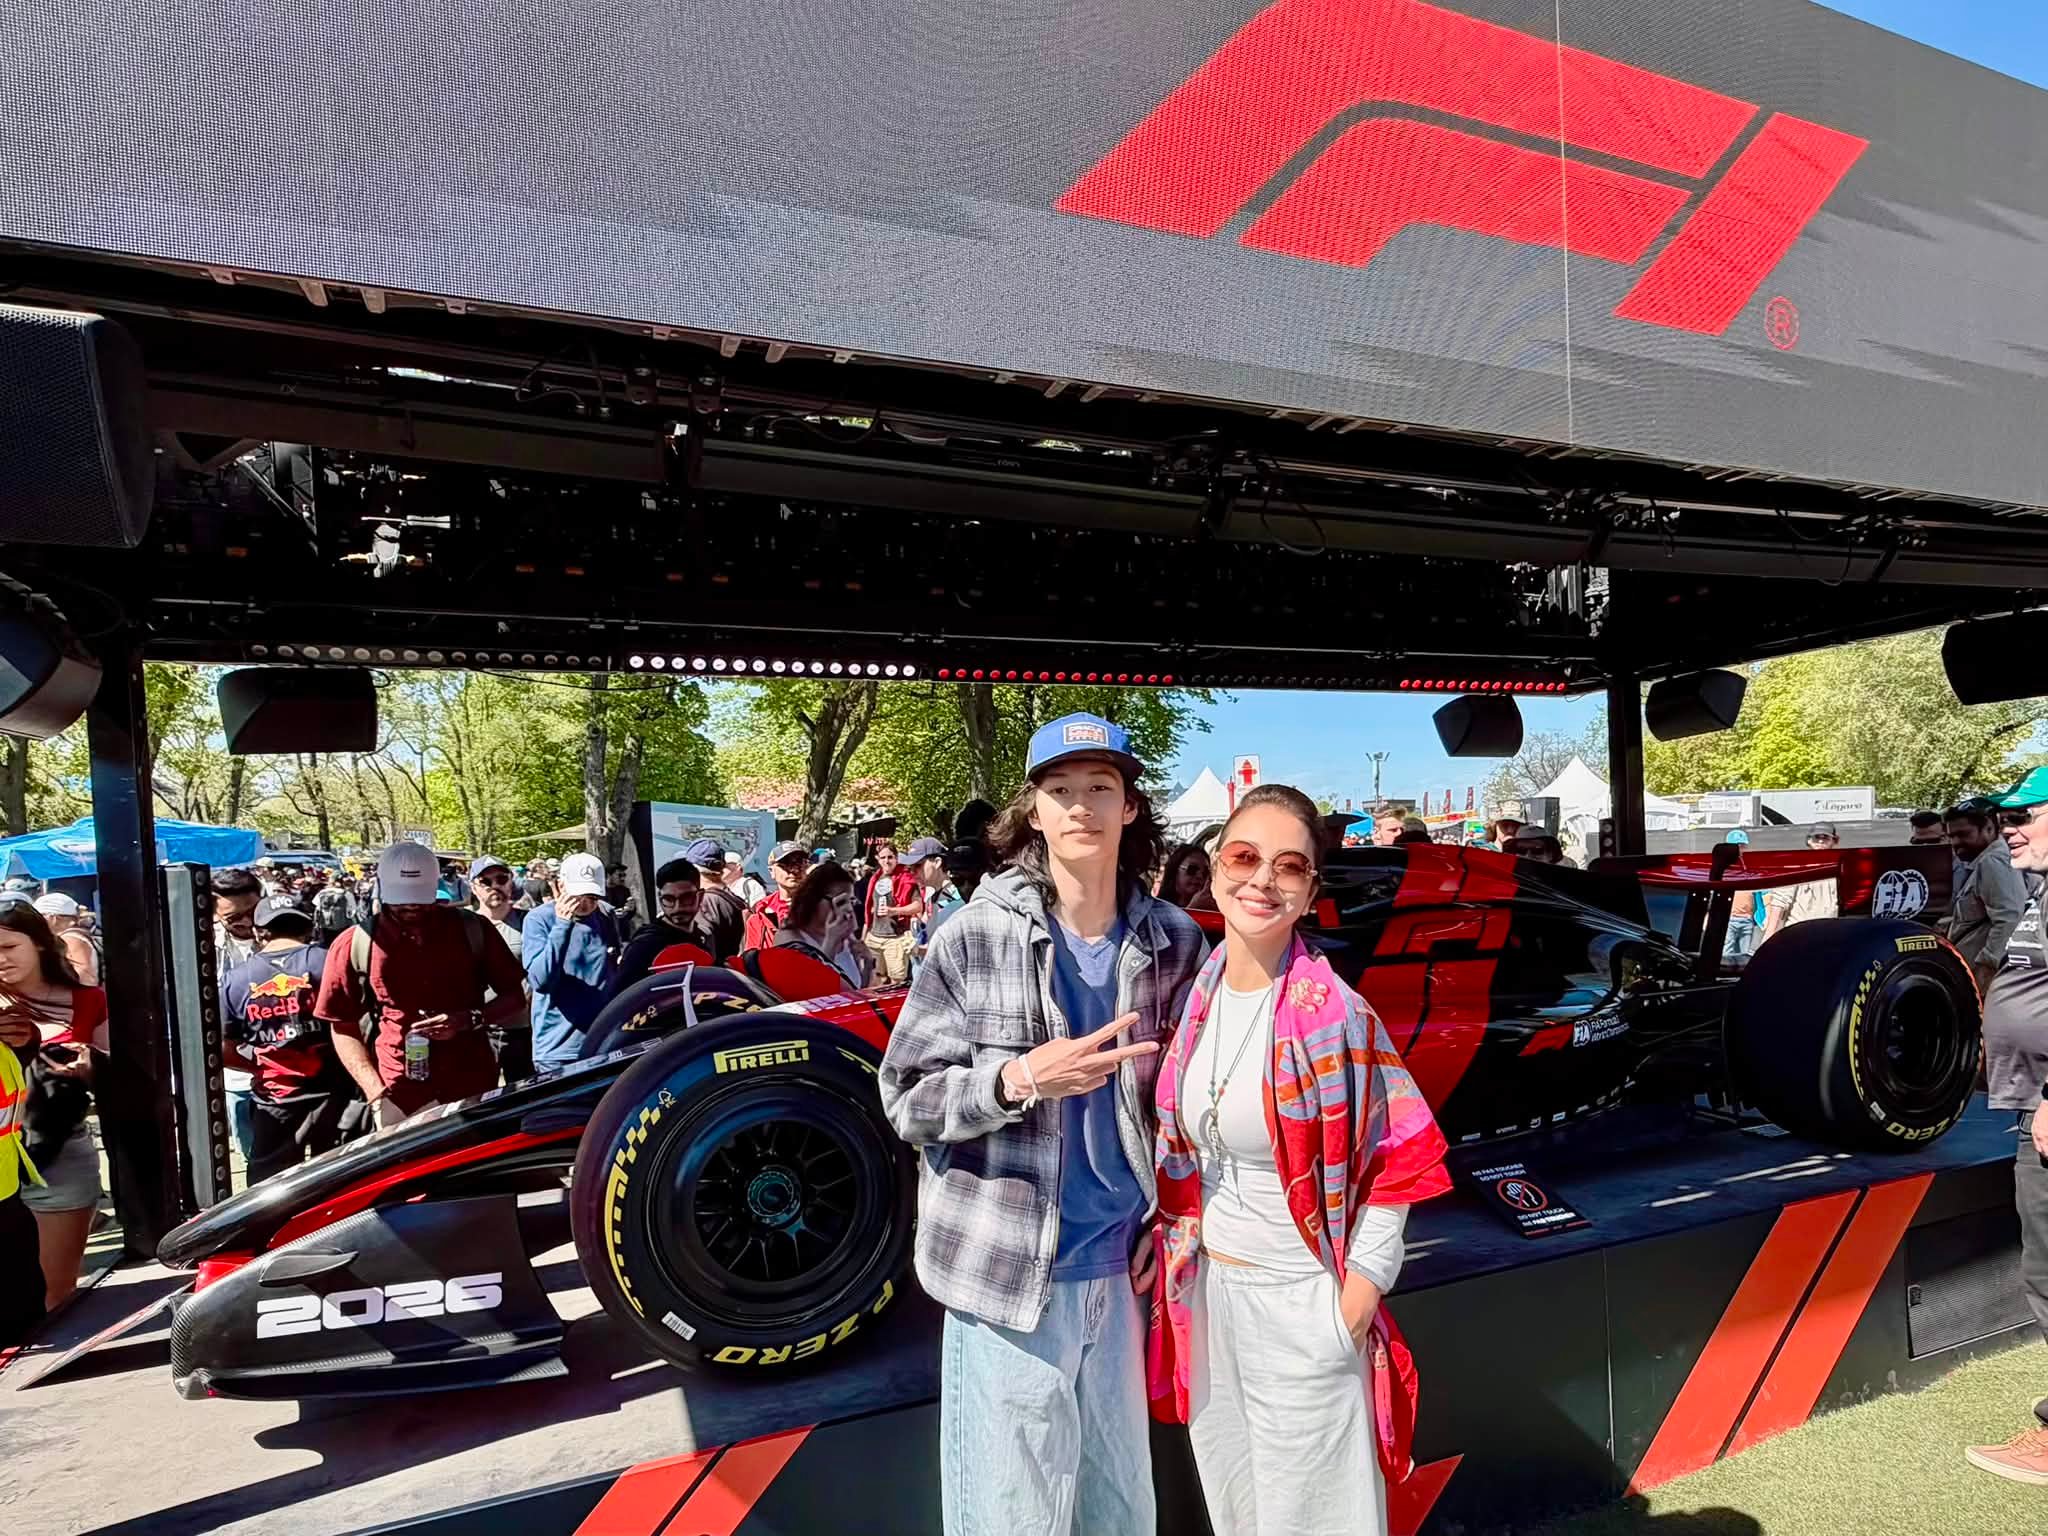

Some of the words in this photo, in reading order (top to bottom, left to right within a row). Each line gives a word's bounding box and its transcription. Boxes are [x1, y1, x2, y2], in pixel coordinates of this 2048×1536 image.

[1053, 0, 1870, 336] F1
[1876, 882, 1921, 914] FIA
[1895, 935, 1938, 952] PIRELLI
[713, 1040, 809, 1074] PIRELLI
[1886, 1117, 1950, 1141] ZERO
[256, 1271, 503, 1340] 2026
[872, 1279, 895, 1315] P
[712, 1312, 860, 1366] ZERO
